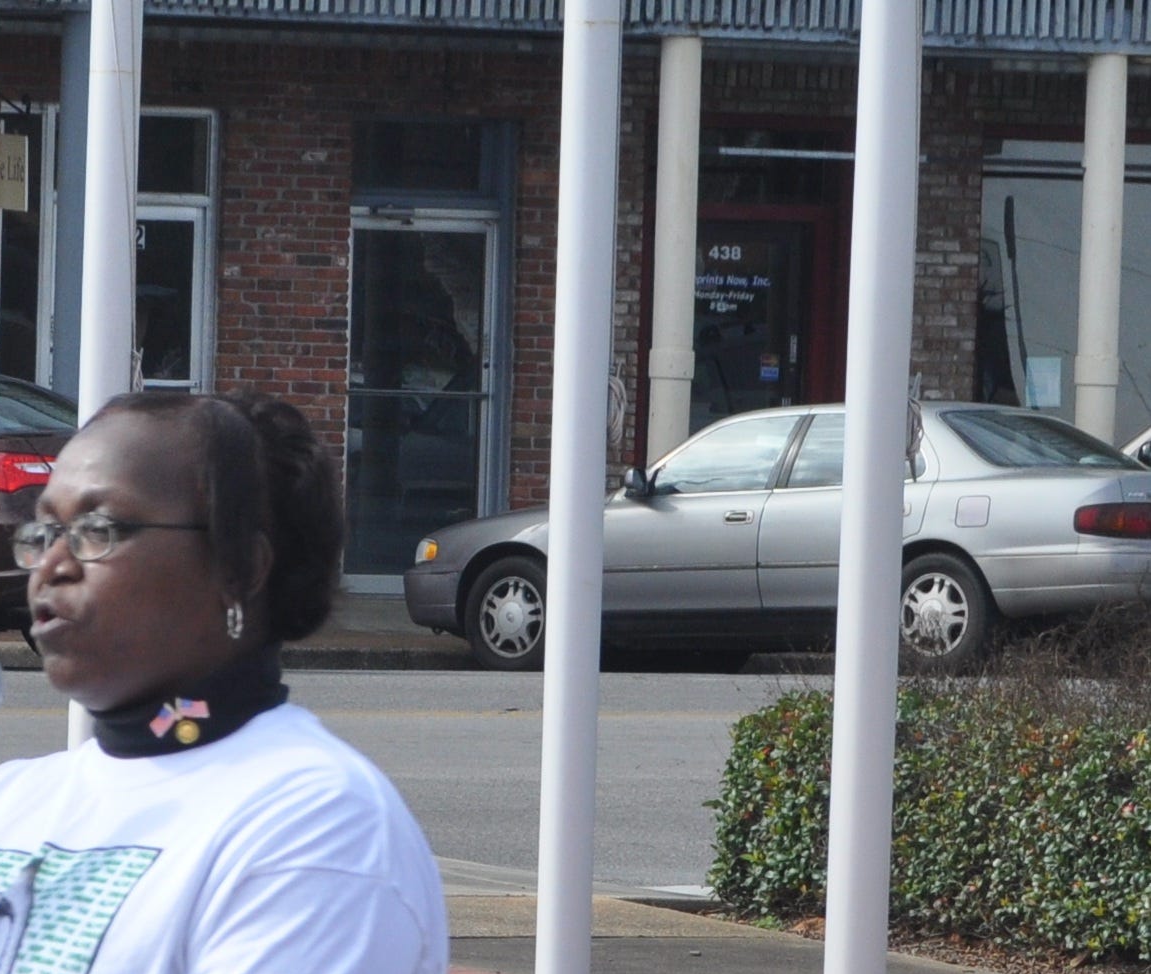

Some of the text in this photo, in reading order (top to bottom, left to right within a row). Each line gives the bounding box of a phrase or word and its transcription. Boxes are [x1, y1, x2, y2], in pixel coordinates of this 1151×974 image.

[7, 154, 25, 182] Life
[708, 245, 742, 261] 438
[696, 274, 724, 287] prints
[753, 275, 771, 286] Inc.
